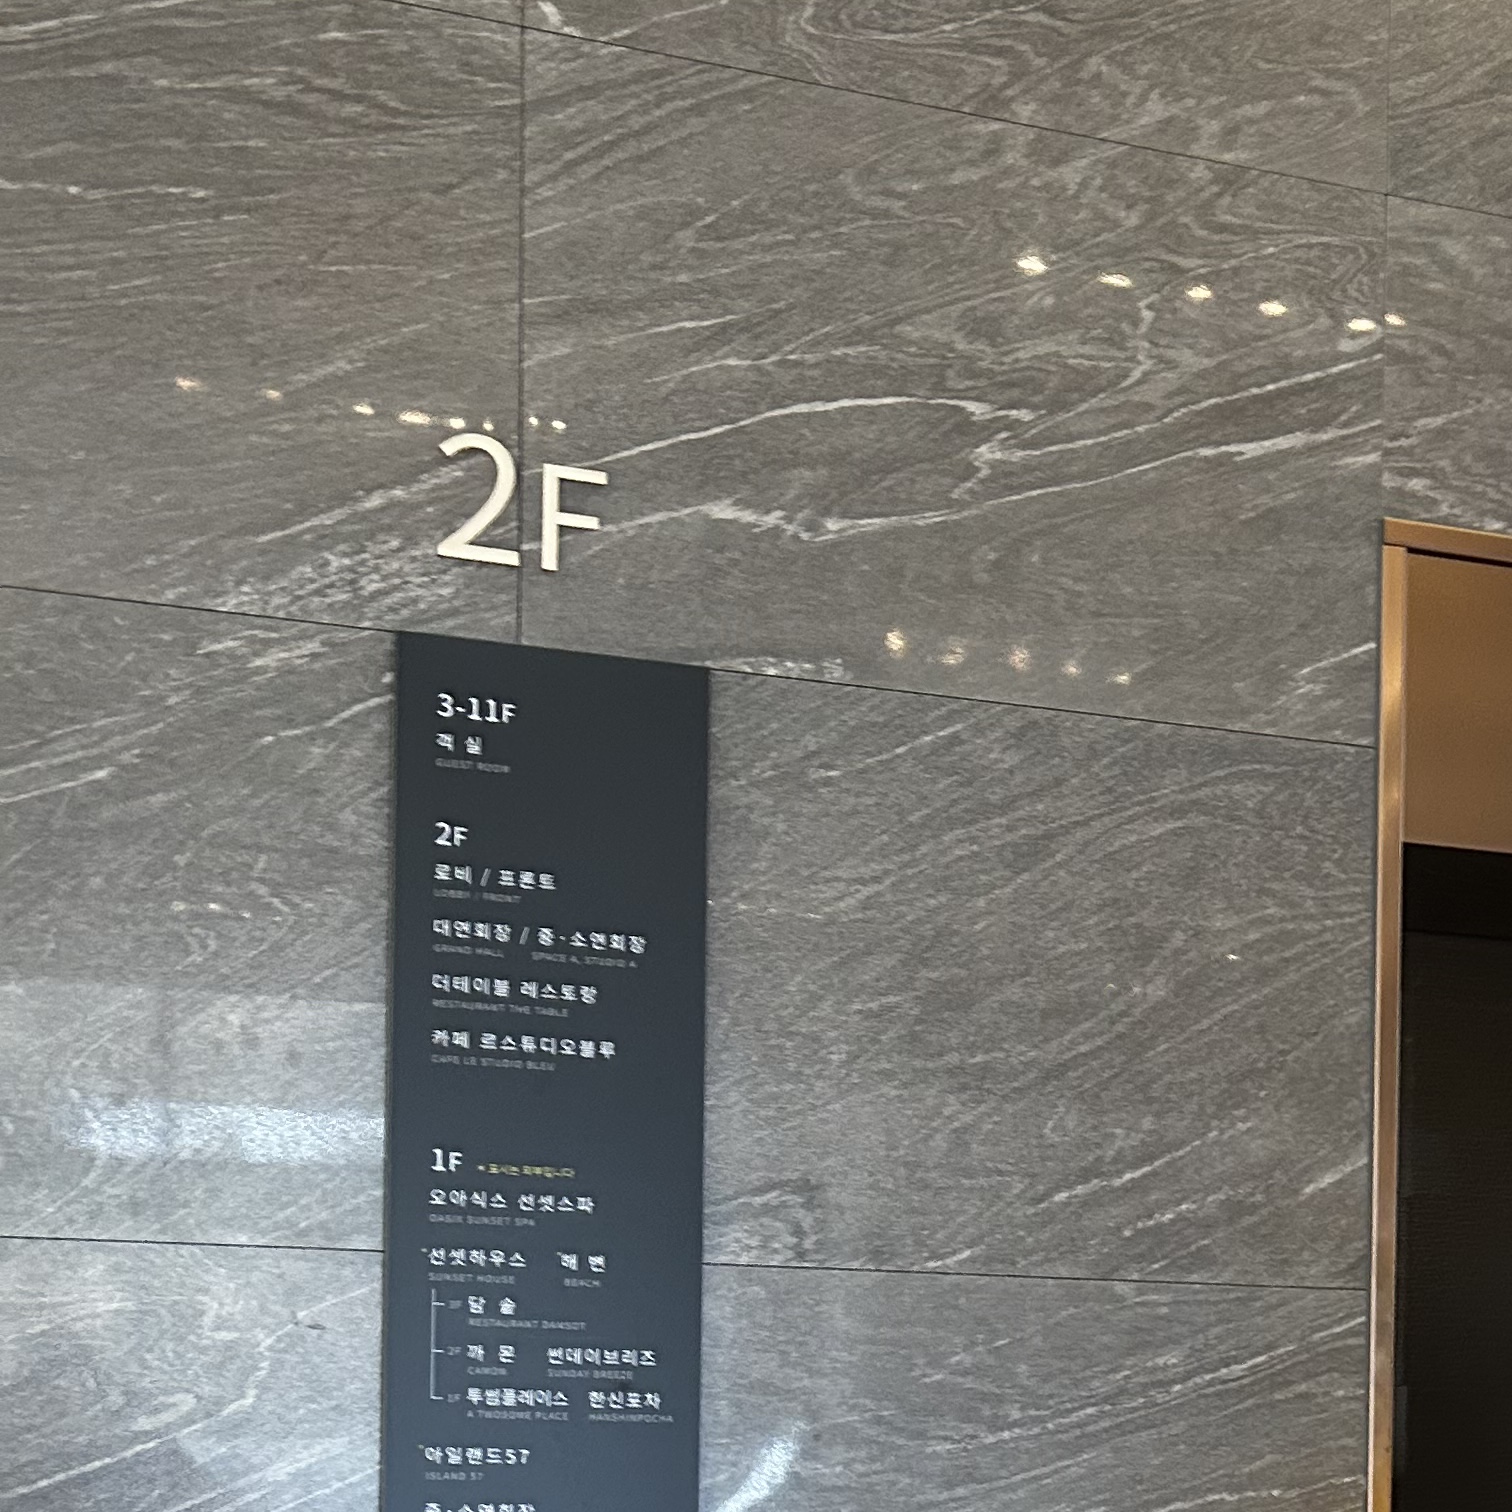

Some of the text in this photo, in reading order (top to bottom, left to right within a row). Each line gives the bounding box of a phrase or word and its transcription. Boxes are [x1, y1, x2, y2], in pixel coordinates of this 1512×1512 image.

[437, 432, 608, 571] 2F
[436, 692, 517, 724] 3-11F
[434, 821, 469, 847] 2F
[433, 863, 472, 884] 로비
[498, 869, 557, 890] 프론트
[432, 918, 512, 943] 대연회장
[432, 973, 599, 1005] 더테이블 레스토랑
[431, 1028, 471, 1049] 카페
[431, 1148, 463, 1172] 1F
[428, 1188, 595, 1215] 오아식스 선셋스파
[427, 1247, 527, 1267] 선셋하우스
[466, 1387, 662, 1410] 투썸플레이스 한신포차
[424, 1446, 530, 1465] 아일랜드57
